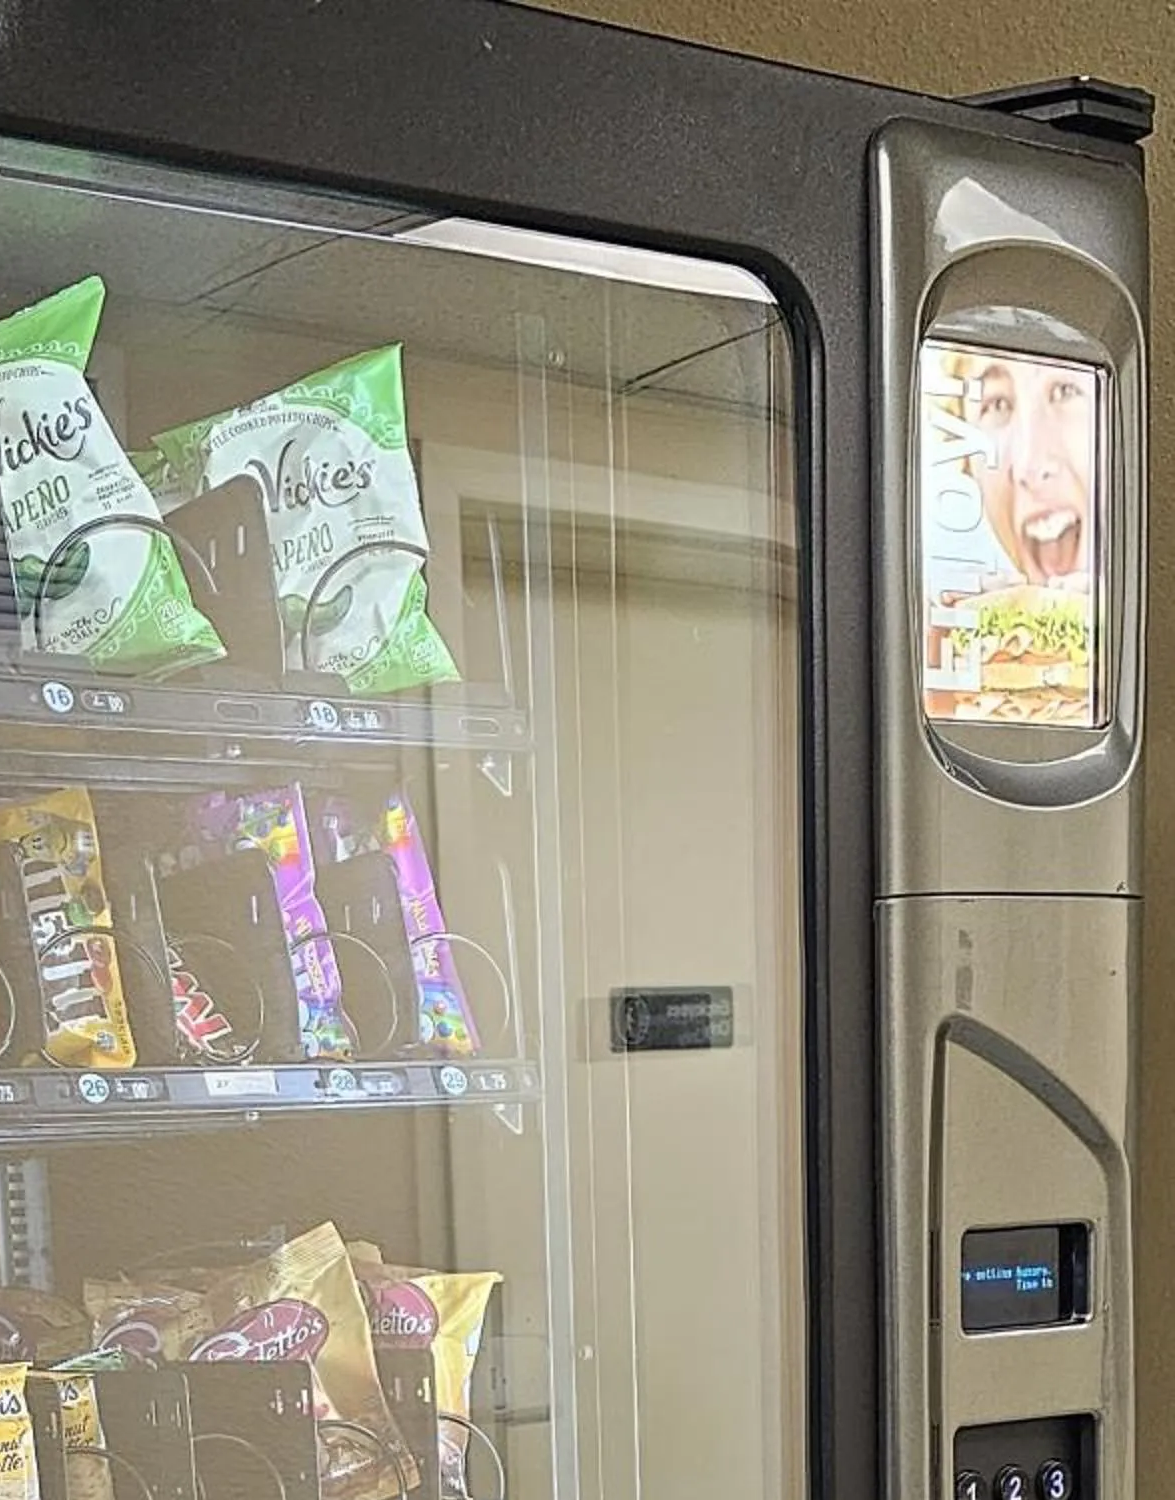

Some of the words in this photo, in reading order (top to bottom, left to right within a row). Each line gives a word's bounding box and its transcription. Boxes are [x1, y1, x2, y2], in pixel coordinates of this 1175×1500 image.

[245, 439, 375, 513] Vickie's
[48, 685, 71, 704] 16
[83, 1080, 107, 1097] 26
[443, 1072, 466, 1089] 29
[1050, 1469, 1064, 1498] 3
